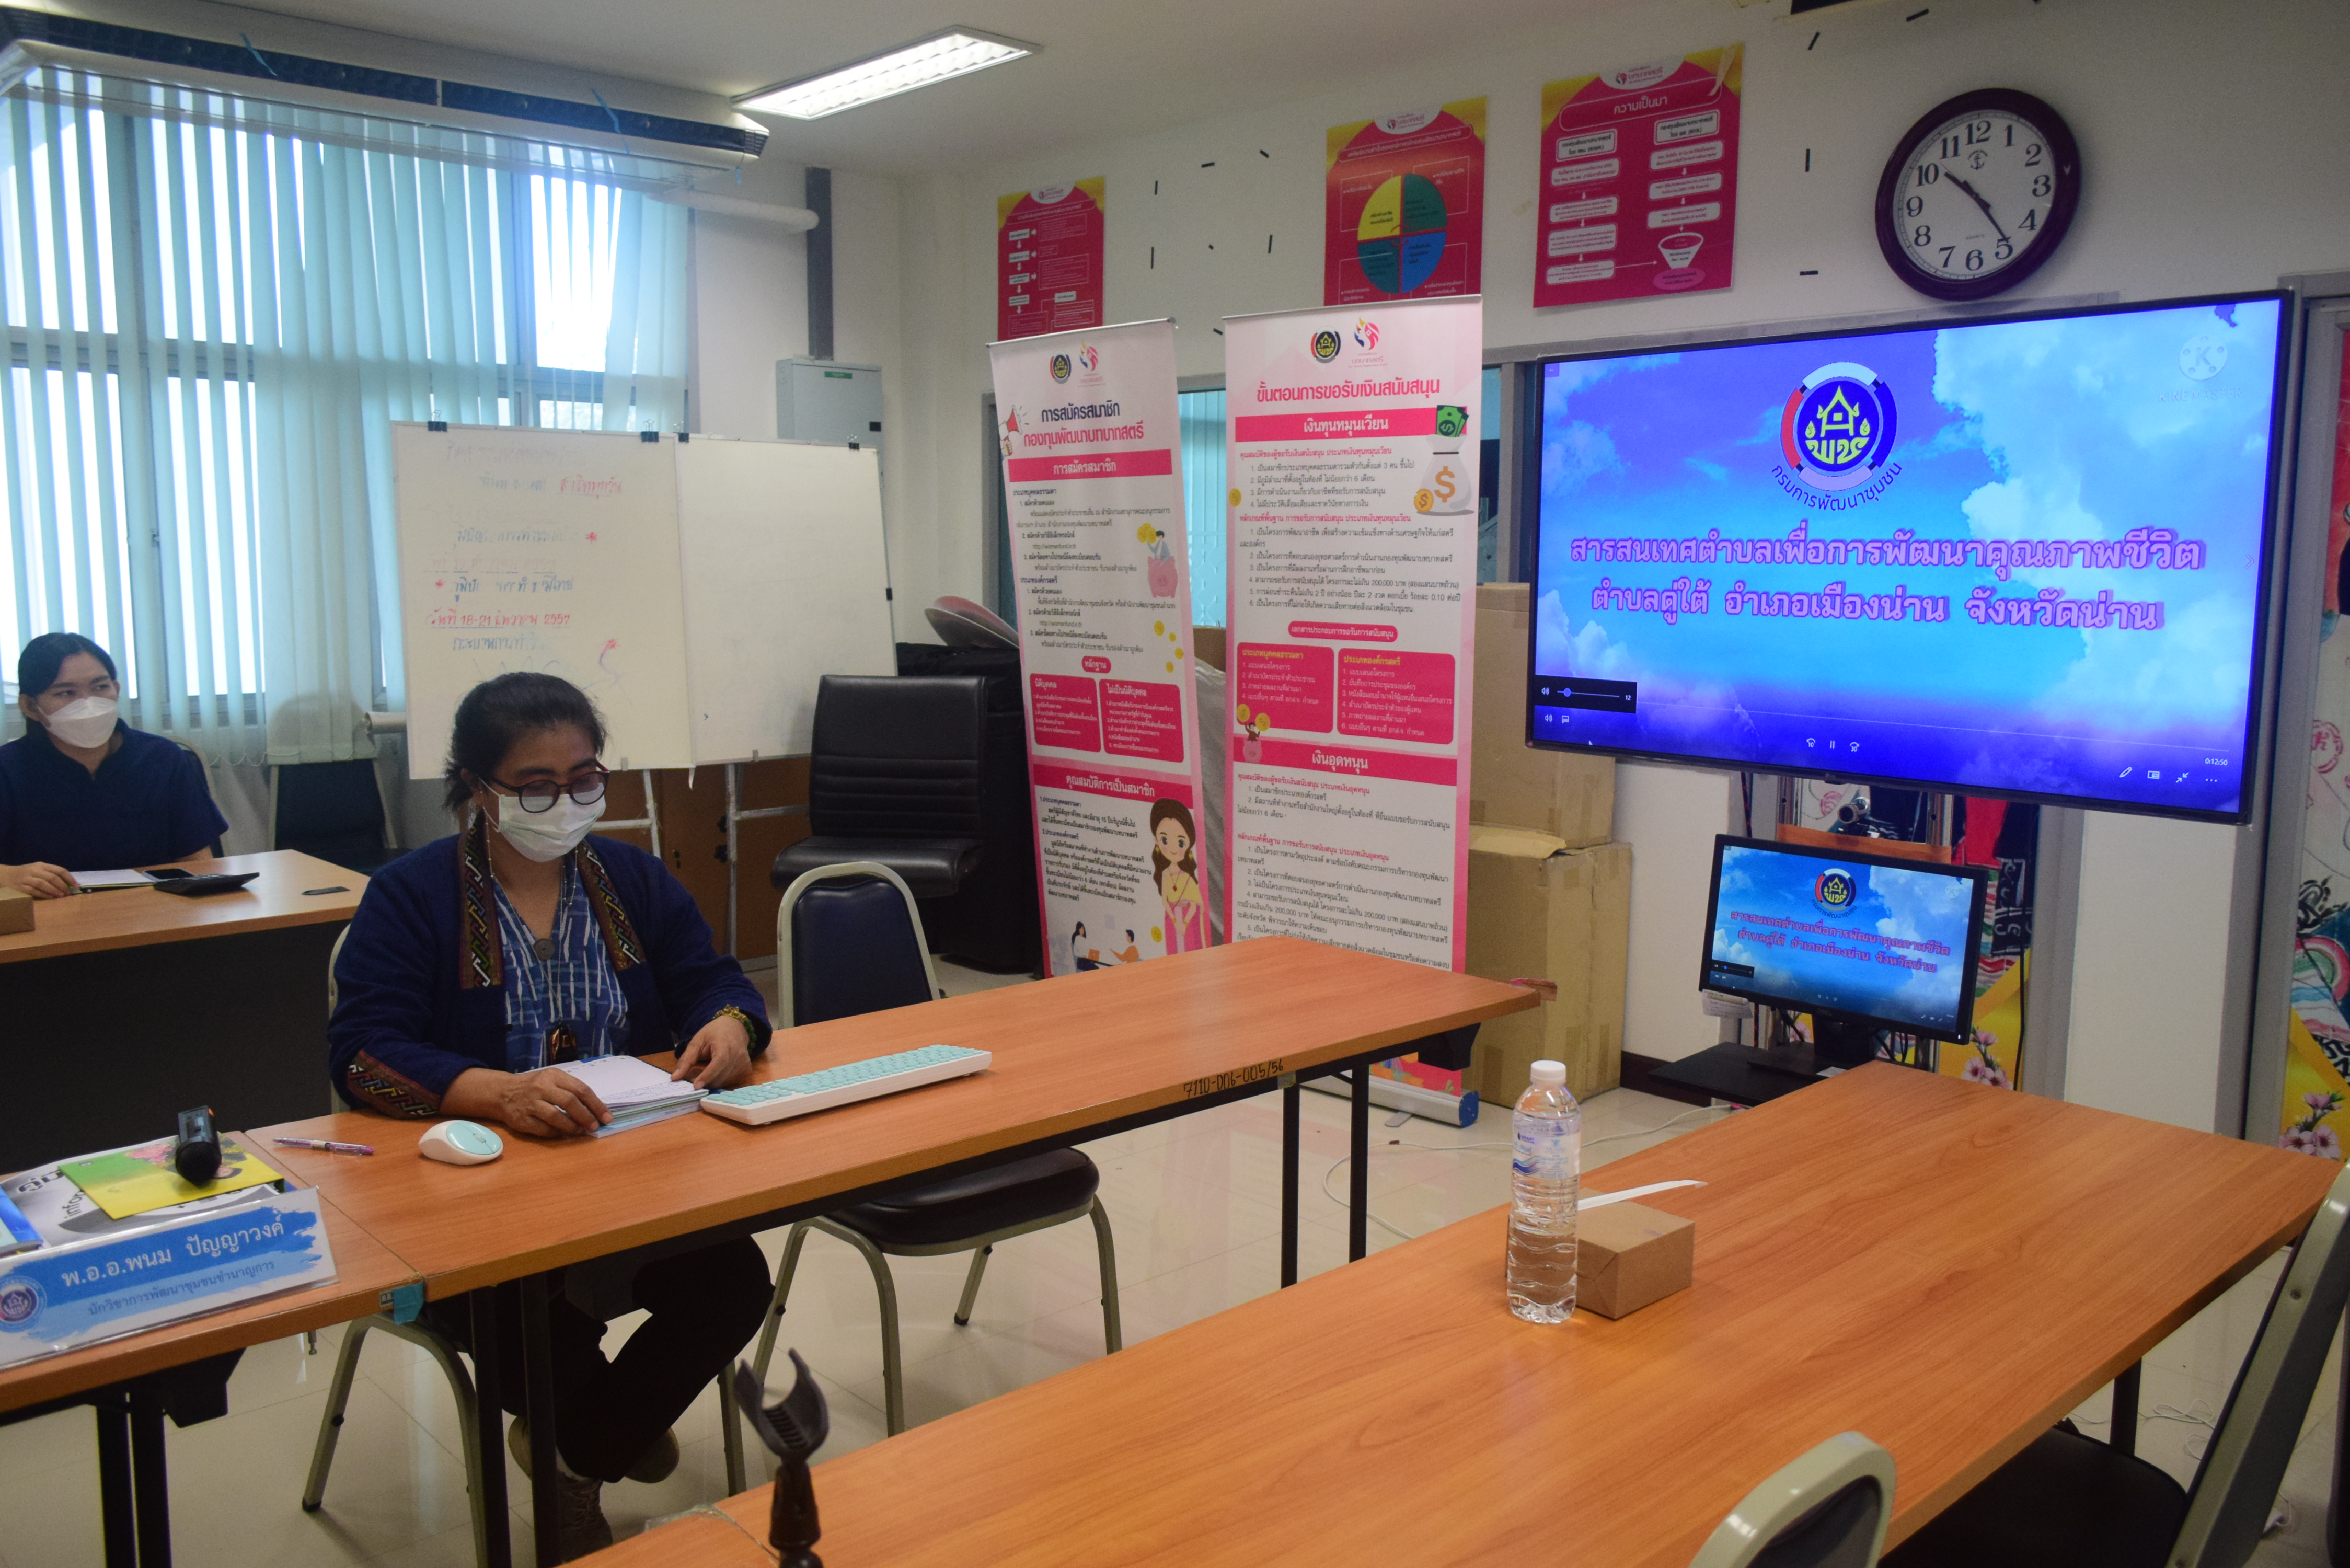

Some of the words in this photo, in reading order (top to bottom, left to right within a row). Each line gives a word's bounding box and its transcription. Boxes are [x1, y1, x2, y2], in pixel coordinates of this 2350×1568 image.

[1614, 96, 1667, 114] ความเป็นมา
[1965, 121, 1991, 145] 12
[2004, 125, 2014, 147] 1
[1940, 135, 1960, 159] 11
[2025, 144, 2042, 167] 2
[1916, 163, 1939, 187] 10
[2032, 175, 2052, 197] 3
[1906, 196, 1923, 217] 9
[2018, 209, 2037, 231] 4
[1914, 225, 1931, 246] 8
[1938, 246, 1956, 268] 7
[1995, 236, 2014, 260] 5
[1965, 249, 1984, 271] 6
[1257, 376, 1440, 403] ขั้นตอนการขอรับเงินสนับสนุน
[2158, 388, 2242, 402] KINEMASTER
[1042, 399, 1120, 422] การสมัครสมาชิก
[1024, 420, 1144, 449] กองทุนพัฒนาบทบาทสตรี
[1304, 416, 1389, 437] เงินทุนหมุนเวียน
[1053, 457, 1116, 475] การสมัครสมาชิก
[1771, 462, 1903, 511] กรมการพัฒนาชุมชน
[1570, 520, 2201, 580] สารสนเทศตำบลเพื่อการพัฒนาคุณภาพชีวิต
[1591, 578, 1710, 625] ตำบลดู่ใต้
[1725, 580, 1949, 623] อำเภอเมืองน่าน
[1966, 586, 2164, 631] จังหวัดน่าน
[460, 614, 491, 626] 18-21
[544, 614, 570, 625] 2557
[1292, 627, 1393, 639] เอกสารประกอบการขอรับการสนับสนุน
[1312, 750, 1368, 774] เงินอุดหนุน
[1066, 775, 1155, 797] คุณสมบัติการเป็นสมาชิก
[1238, 856, 1264, 865] บทบาทสตรี
[1811, 897, 1858, 919] กรมการพัฒนาชุมชน
[1731, 911, 1950, 957] สารสนเทศตำบลเพื่อการพัฒนาคุณภาพชีวิต
[1738, 928, 1785, 948] ตำบลดู่ใต้
[1791, 937, 1870, 962] อำเภอเมืองน่าน
[1876, 951, 1937, 974] จังหวัดน่าน
[62, 1249, 172, 1286] พ.อ.อ.พนม
[186, 1215, 284, 1258] ปัญญาวงค์
[89, 1260, 274, 1316] นักวิชาการพัฒนาชุมชนชำนาญการ
